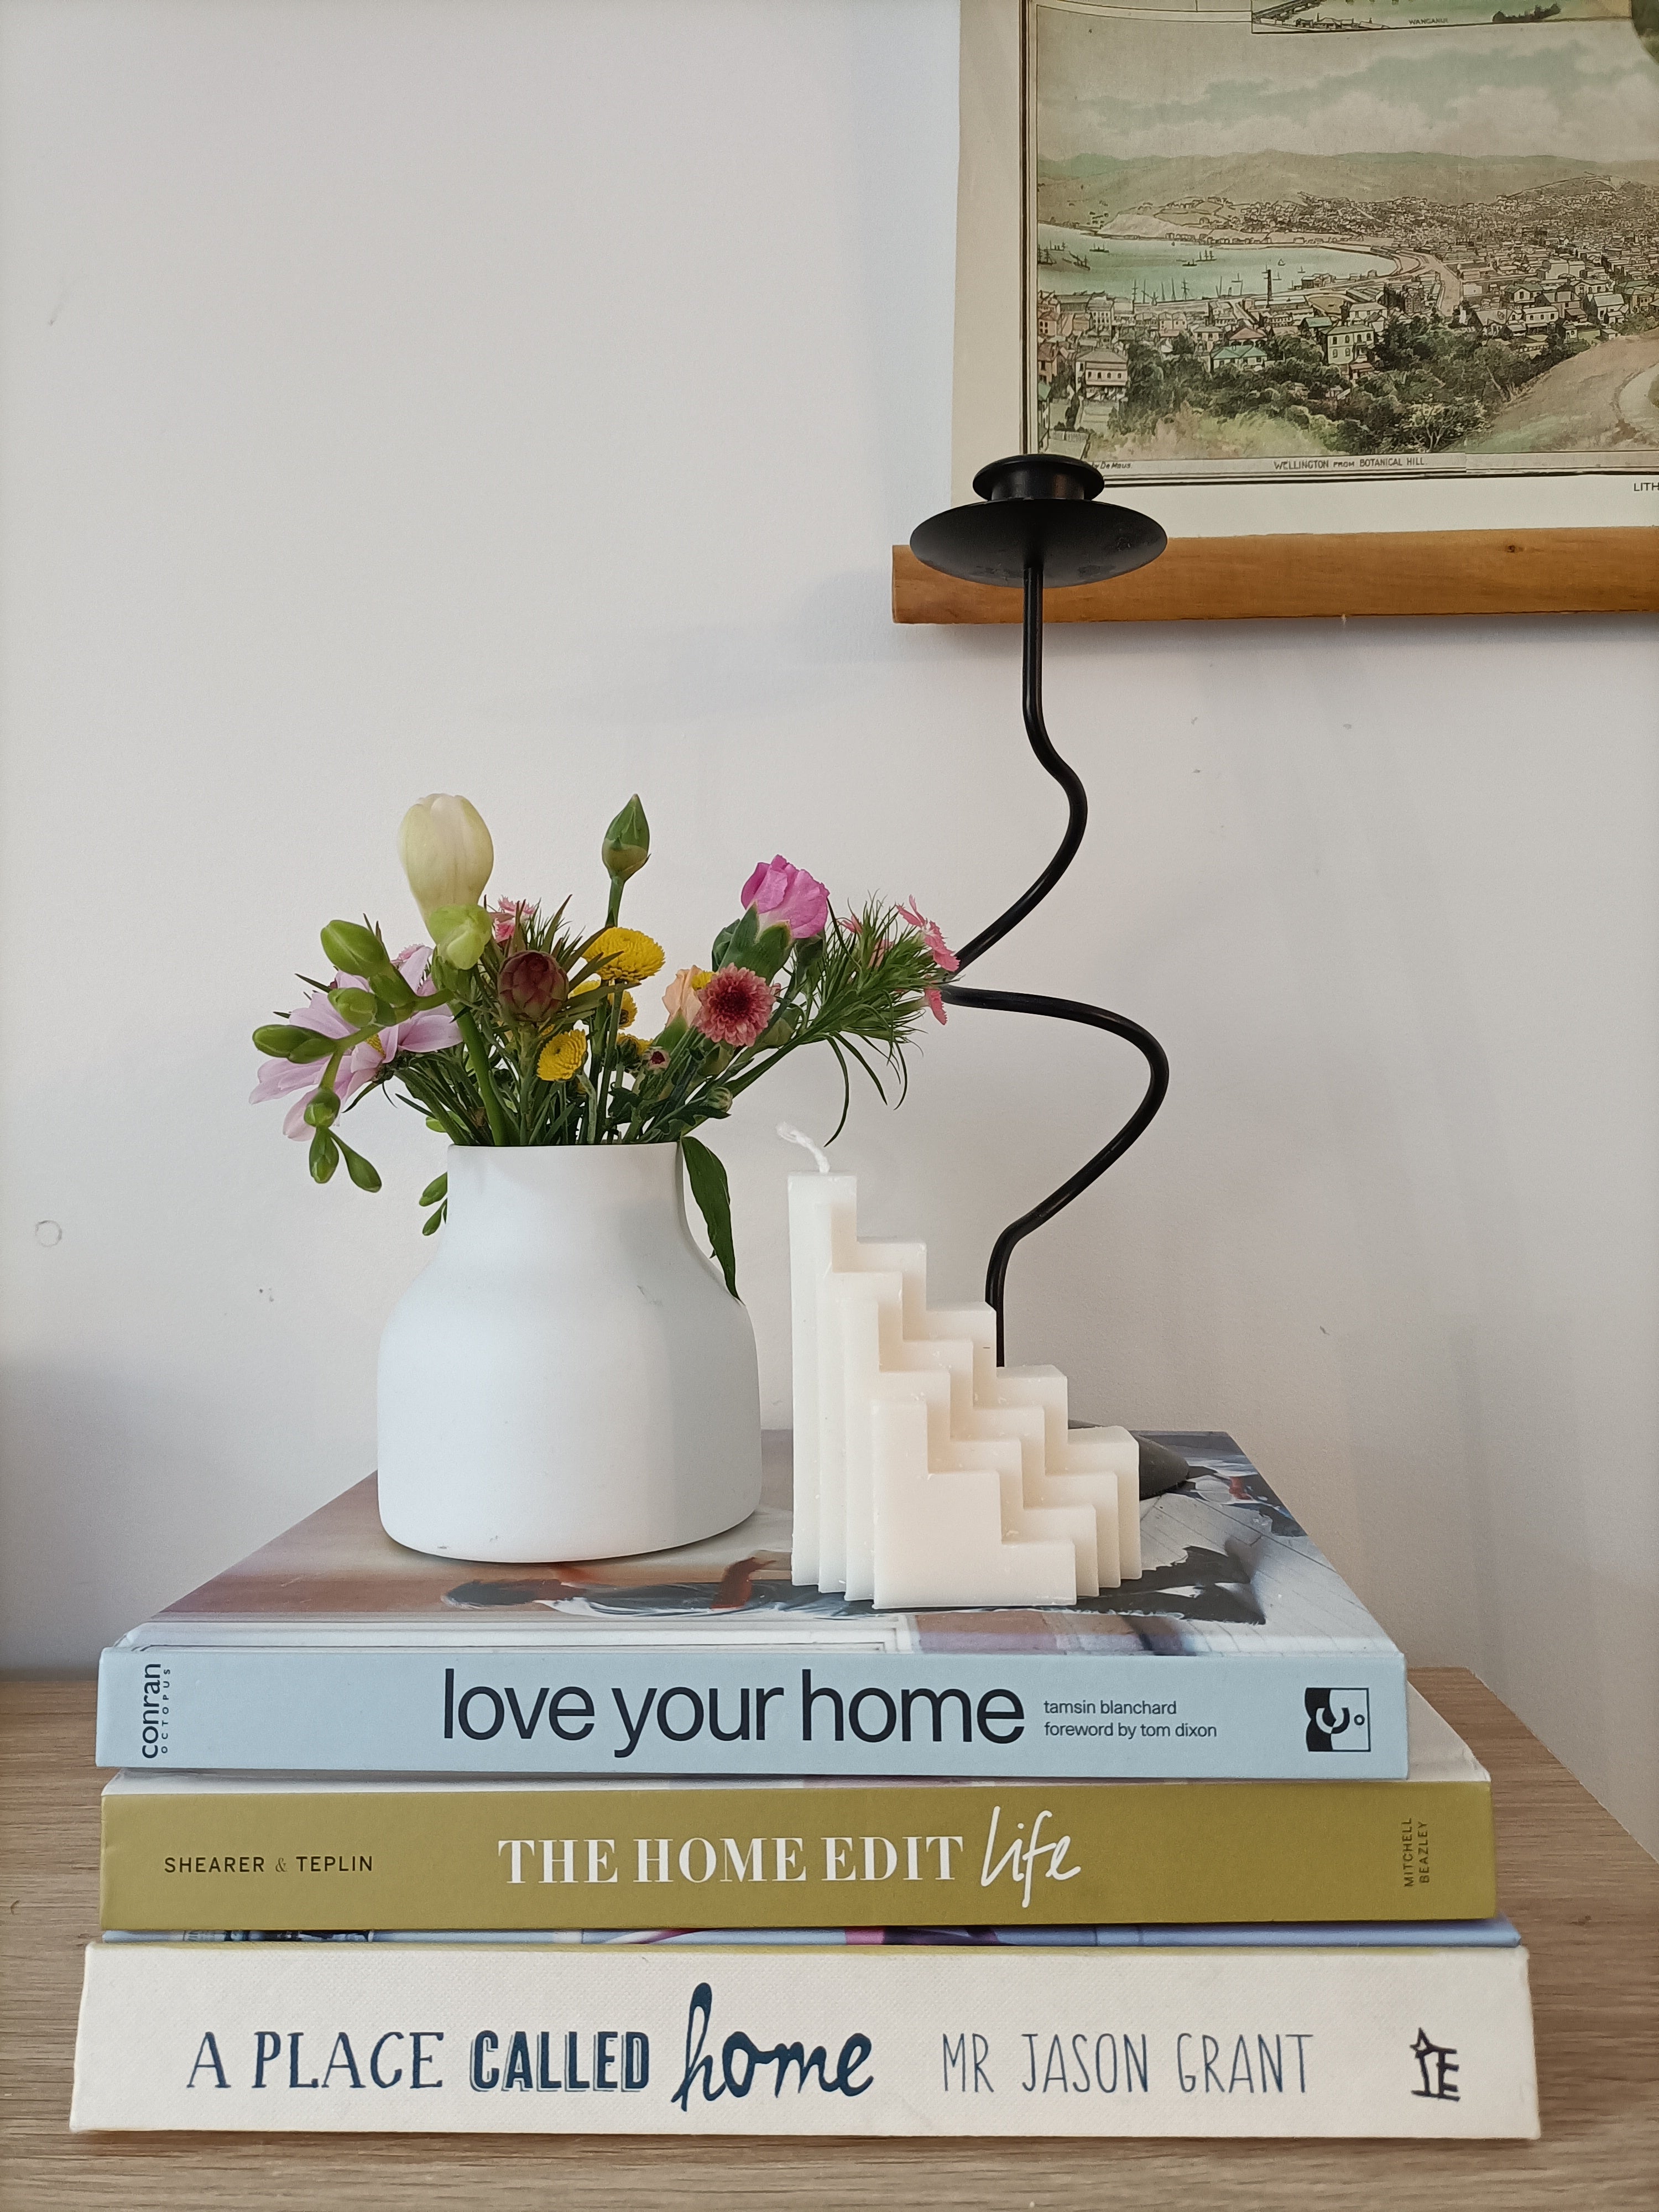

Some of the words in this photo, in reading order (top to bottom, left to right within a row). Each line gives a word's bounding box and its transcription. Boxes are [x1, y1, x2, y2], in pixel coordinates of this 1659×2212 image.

[1274, 459, 1329, 470] WELLINGTON
[1360, 458, 1403, 467] BOTANICAL
[142, 1663, 161, 1759] conran
[161, 1669, 171, 1754] OCTOPUS
[445, 1668, 596, 1741] love
[612, 1687, 785, 1759] your
[802, 1669, 1026, 1744] home
[1044, 1700, 1096, 1714] tamsin
[1100, 1700, 1177, 1715] blanchard
[1044, 1721, 1114, 1736] foreword
[1118, 1723, 1137, 1740] by
[1140, 1724, 1171, 1737] tom
[1175, 1723, 1217, 1738] dixon
[165, 1857, 265, 1873] SHEARER
[275, 1858, 288, 1872] &
[296, 1856, 373, 1872] TEPLIN
[498, 1840, 618, 1884] THE
[633, 1838, 807, 1883] HOME
[821, 1837, 963, 1881] EDIT
[1401, 1818, 1414, 1887] MITCHELL
[1417, 1822, 1430, 1884] BEAZLEY
[187, 2032, 232, 2089] A
[252, 2031, 445, 2090] PLACE
[469, 2030, 650, 2093] CALLED
[670, 1983, 875, 2112] home
[943, 2033, 994, 2093] MR
[1021, 2033, 1148, 2094] JASON
[1177, 2033, 1314, 2094] GRANT
